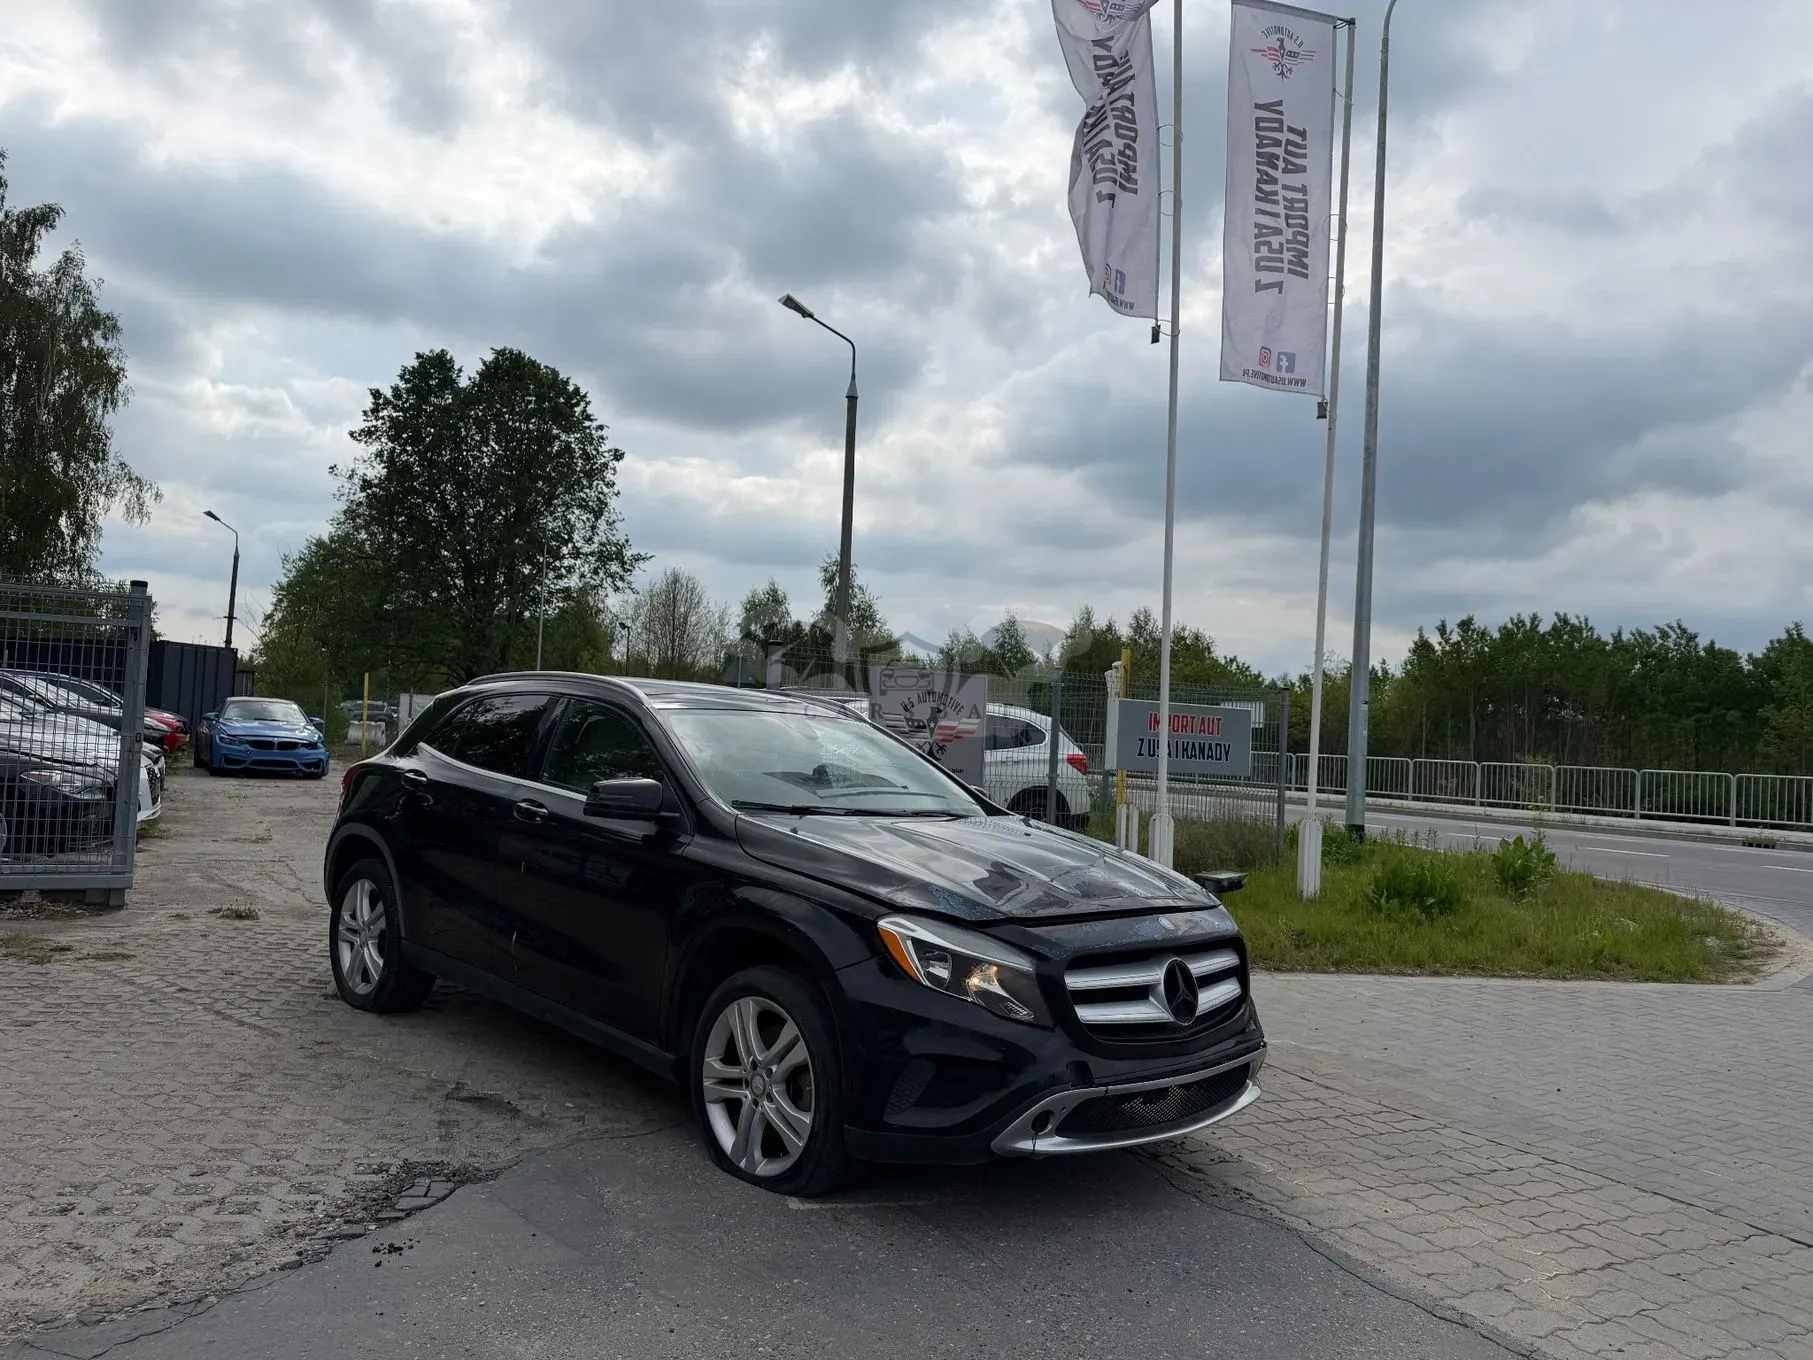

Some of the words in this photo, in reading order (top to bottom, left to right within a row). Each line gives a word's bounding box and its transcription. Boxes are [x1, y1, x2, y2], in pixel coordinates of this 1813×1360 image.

[917, 690, 965, 715] AUTOMOTIVE
[1198, 716, 1223, 736] AUT
[1137, 737, 1145, 757] Z
[1181, 740, 1231, 762] KANADY
